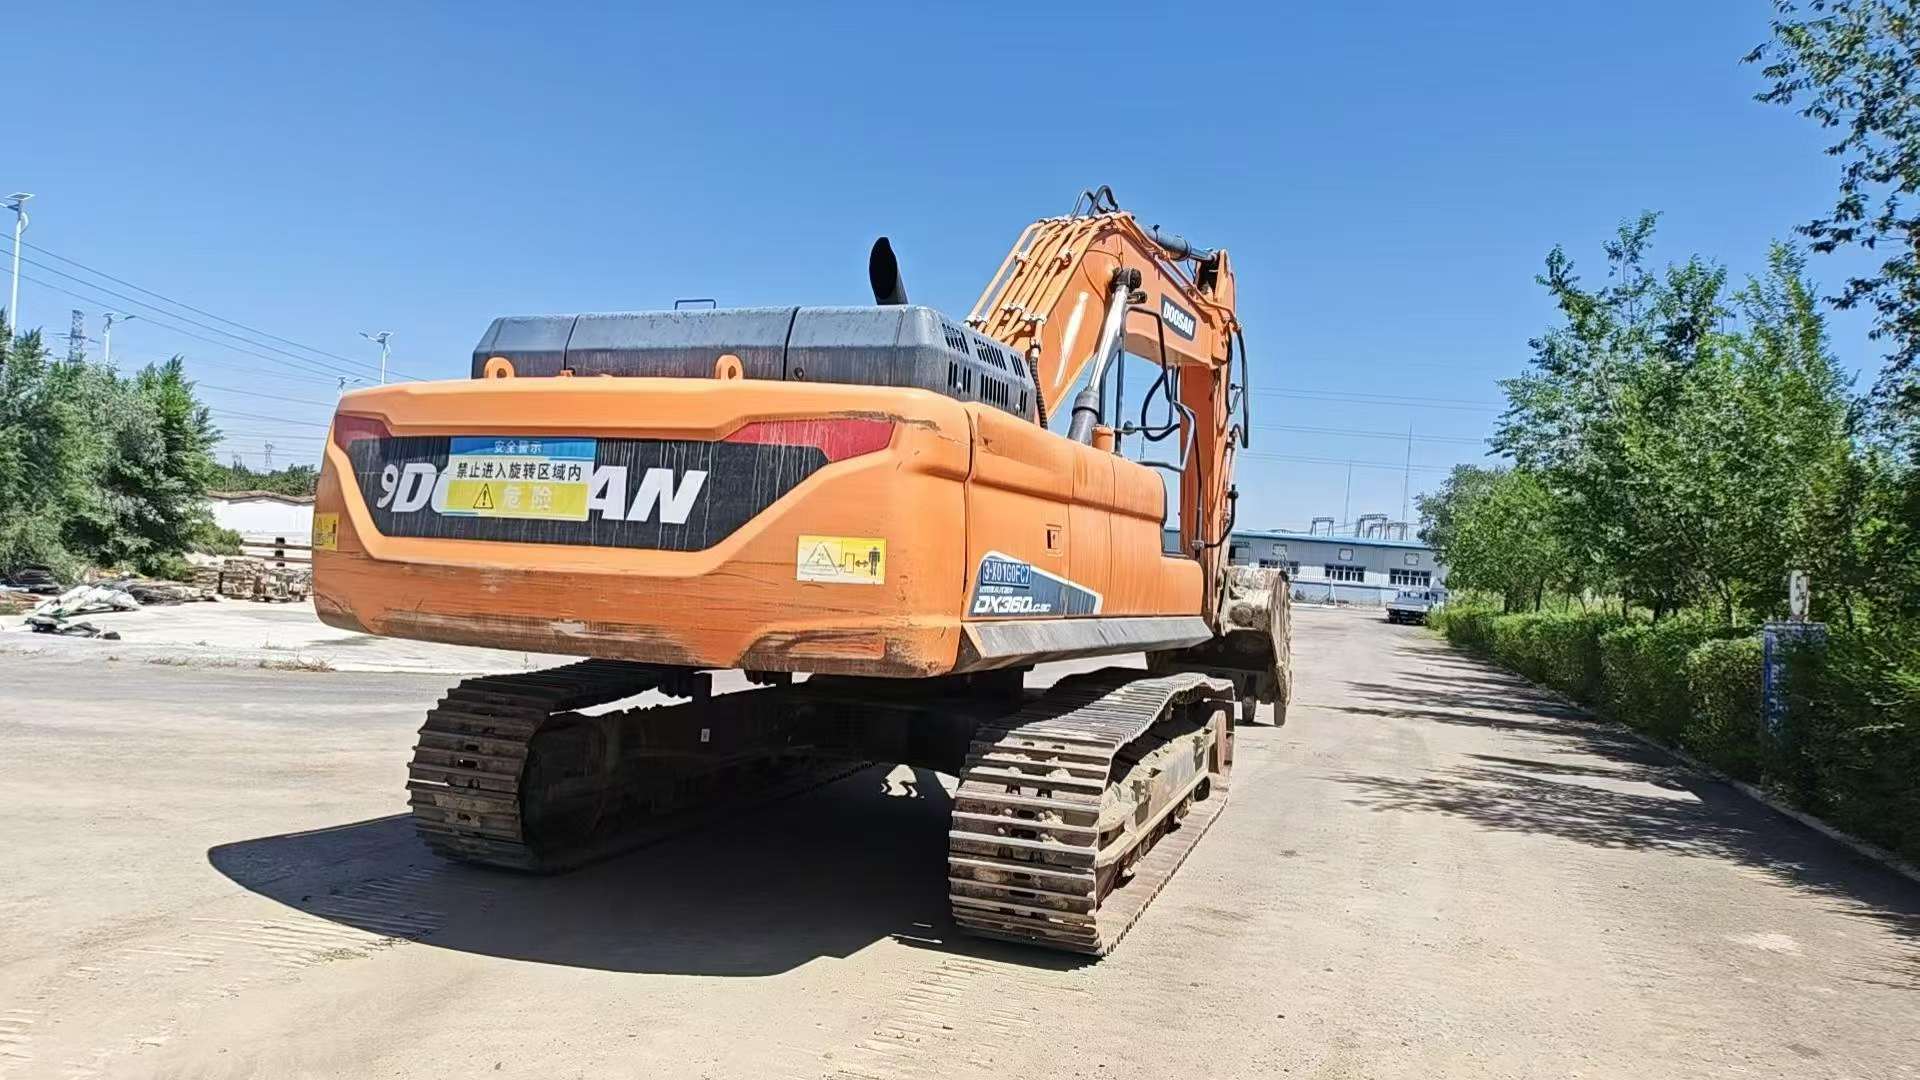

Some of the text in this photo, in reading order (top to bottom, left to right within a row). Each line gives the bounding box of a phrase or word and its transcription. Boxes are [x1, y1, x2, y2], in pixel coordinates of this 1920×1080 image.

[1163, 301, 1194, 337] DOOSAN
[456, 462, 582, 482] 禁止进入旋转区域内
